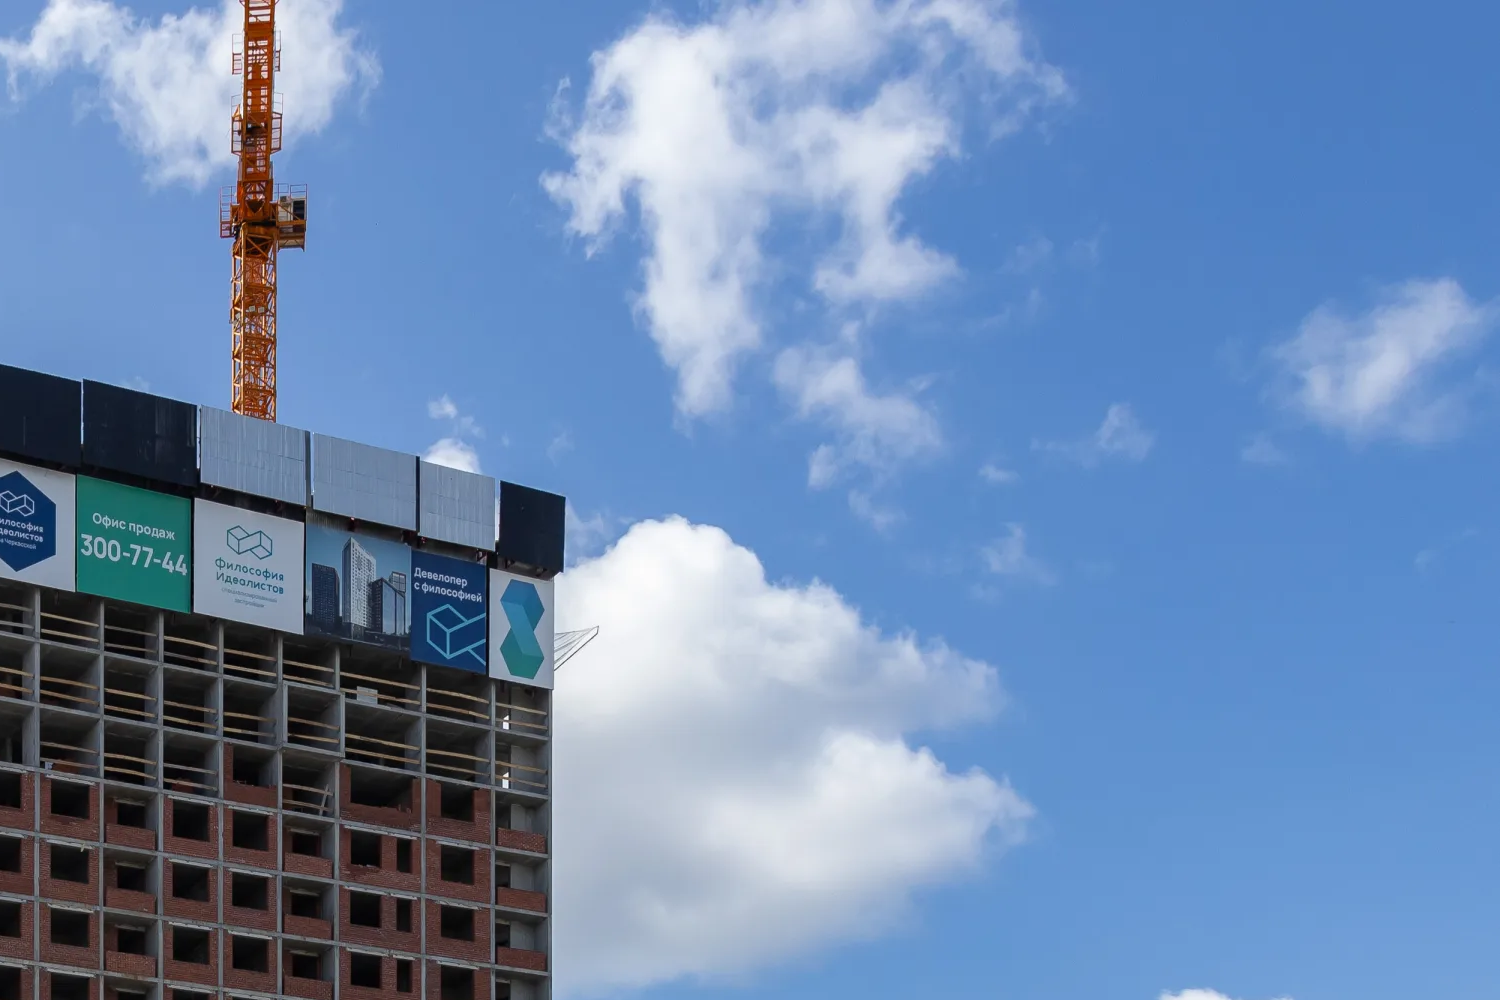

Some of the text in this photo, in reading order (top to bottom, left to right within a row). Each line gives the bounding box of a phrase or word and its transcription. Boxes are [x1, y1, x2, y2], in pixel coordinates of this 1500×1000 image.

[92, 512, 176, 541] Офис продаж
[80, 533, 188, 576] 300-77-44
[214, 556, 284, 582] Философия
[414, 567, 468, 589] Девелопер
[216, 571, 284, 595] Идеалистов
[413, 581, 482, 603] с философией
